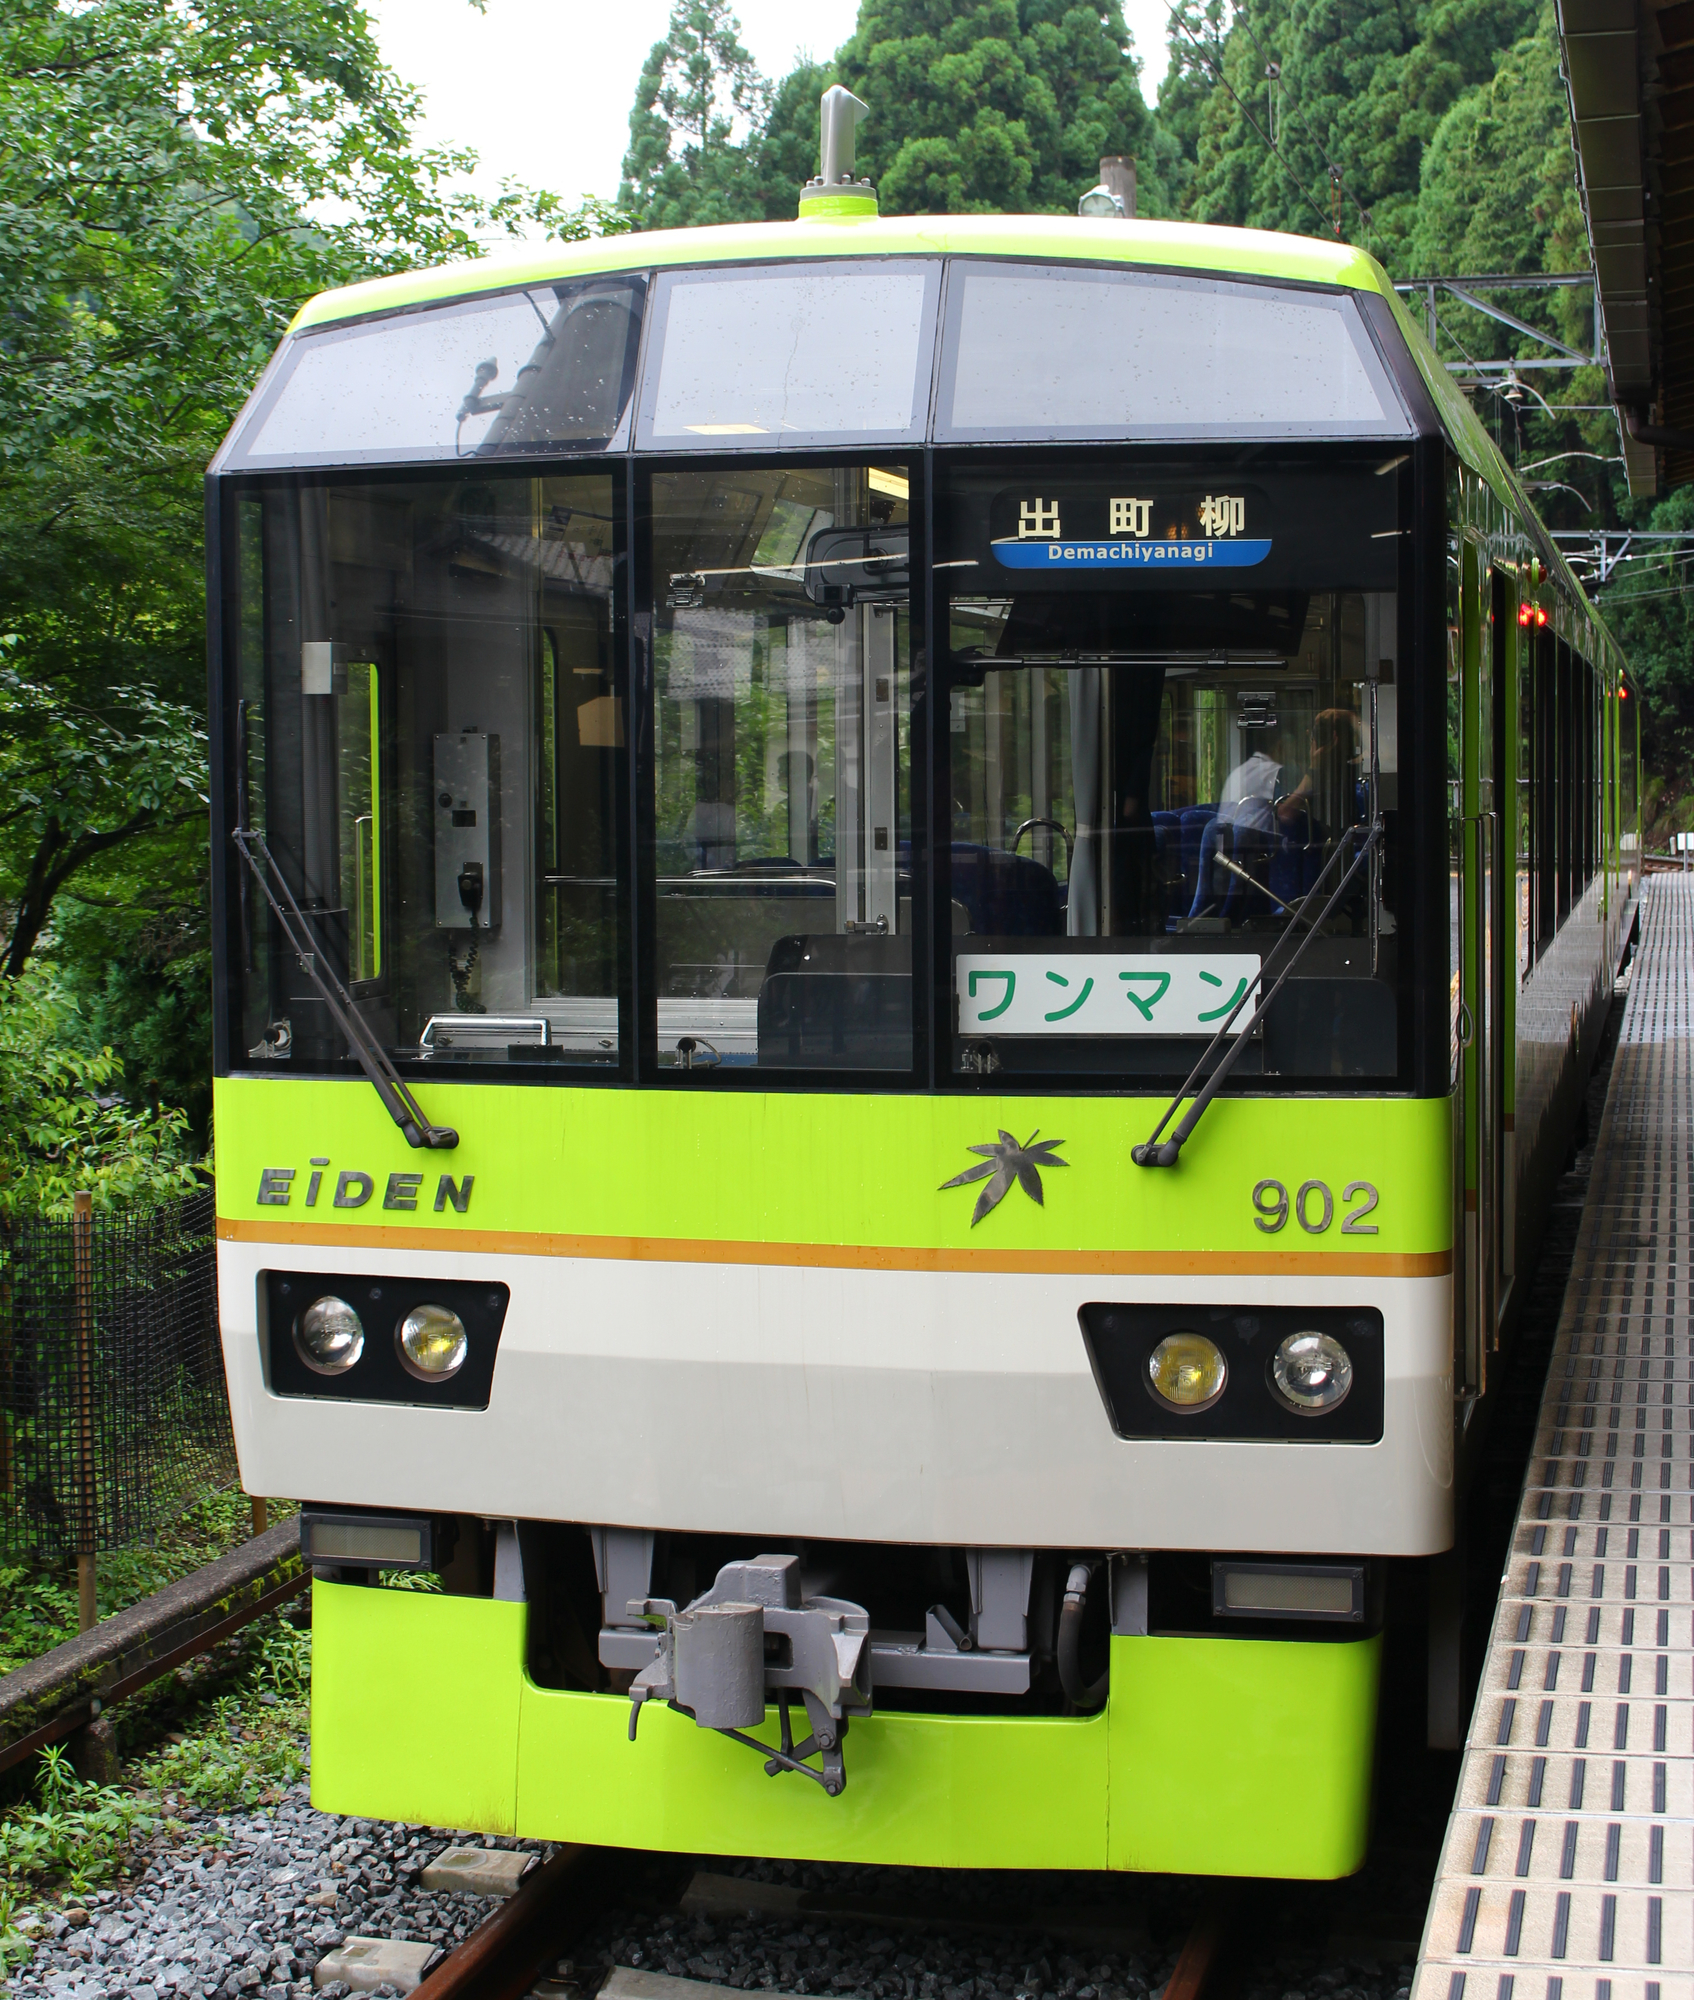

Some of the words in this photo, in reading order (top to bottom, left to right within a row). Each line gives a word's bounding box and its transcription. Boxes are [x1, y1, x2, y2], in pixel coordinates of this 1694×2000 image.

[1018, 495, 1246, 539] 出町柳
[1048, 542, 1214, 562] Demachiyanagi
[968, 970, 1249, 1022] ワンマン
[1252, 1178, 1379, 1234] 902
